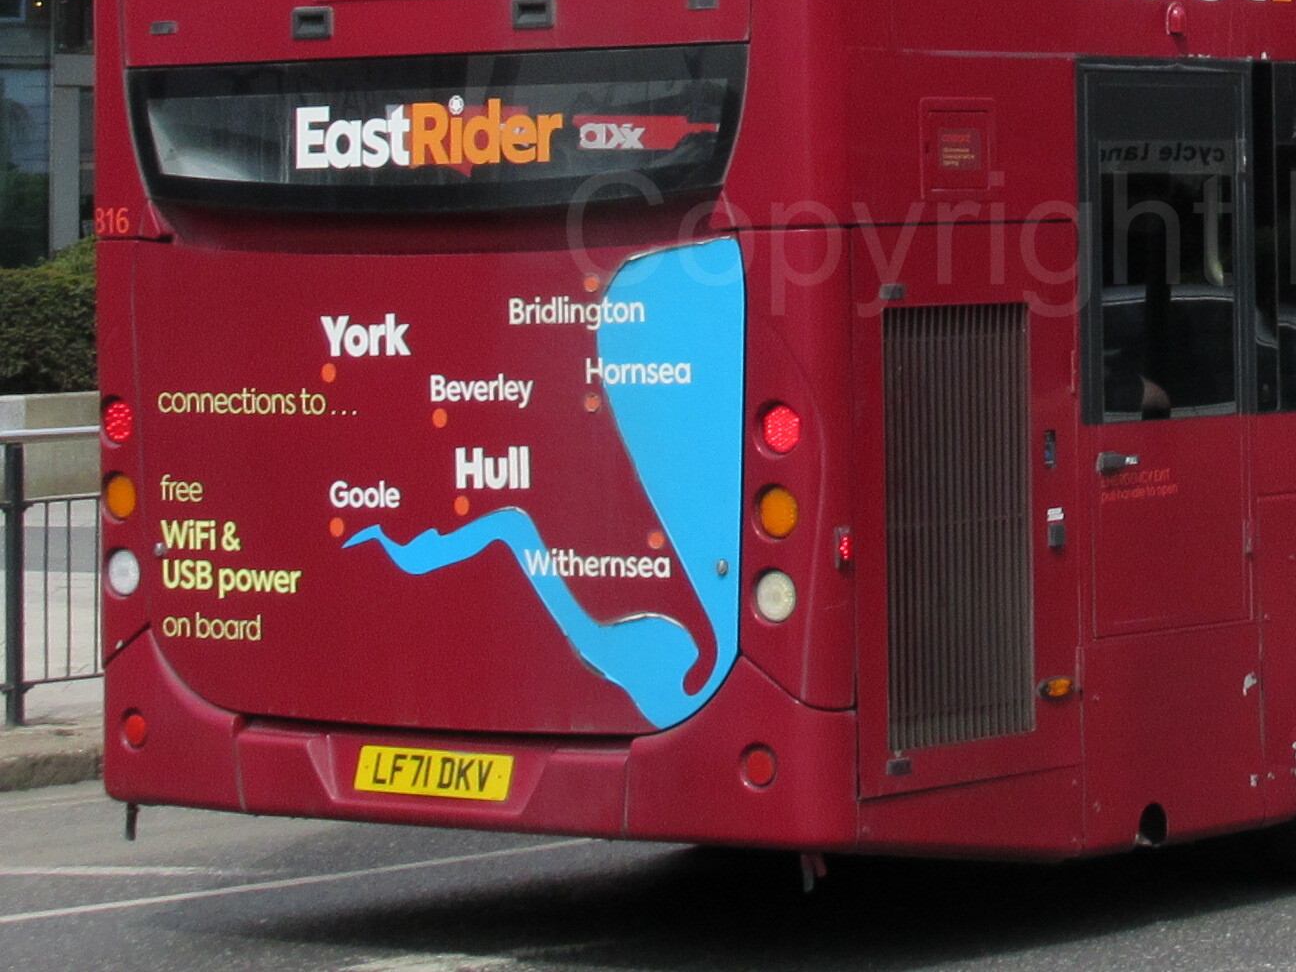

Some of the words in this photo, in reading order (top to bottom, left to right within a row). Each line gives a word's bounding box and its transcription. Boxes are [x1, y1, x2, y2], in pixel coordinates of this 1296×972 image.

[508, 295, 646, 330] Bridlington
[320, 312, 411, 358] York
[585, 357, 692, 385] Hornsea
[157, 387, 297, 415] connections
[429, 373, 534, 409] Beverley
[454, 445, 531, 490] Hull
[160, 474, 204, 503] free
[328, 480, 401, 509] Goole
[160, 519, 217, 551] WiFi
[220, 521, 242, 552] &
[161, 559, 214, 591] USB
[217, 568, 302, 600] power
[523, 549, 672, 579] Withernsea
[162, 616, 191, 638] on
[195, 611, 262, 642] board
[371, 751, 433, 788] LF71
[436, 756, 494, 793] DKV
